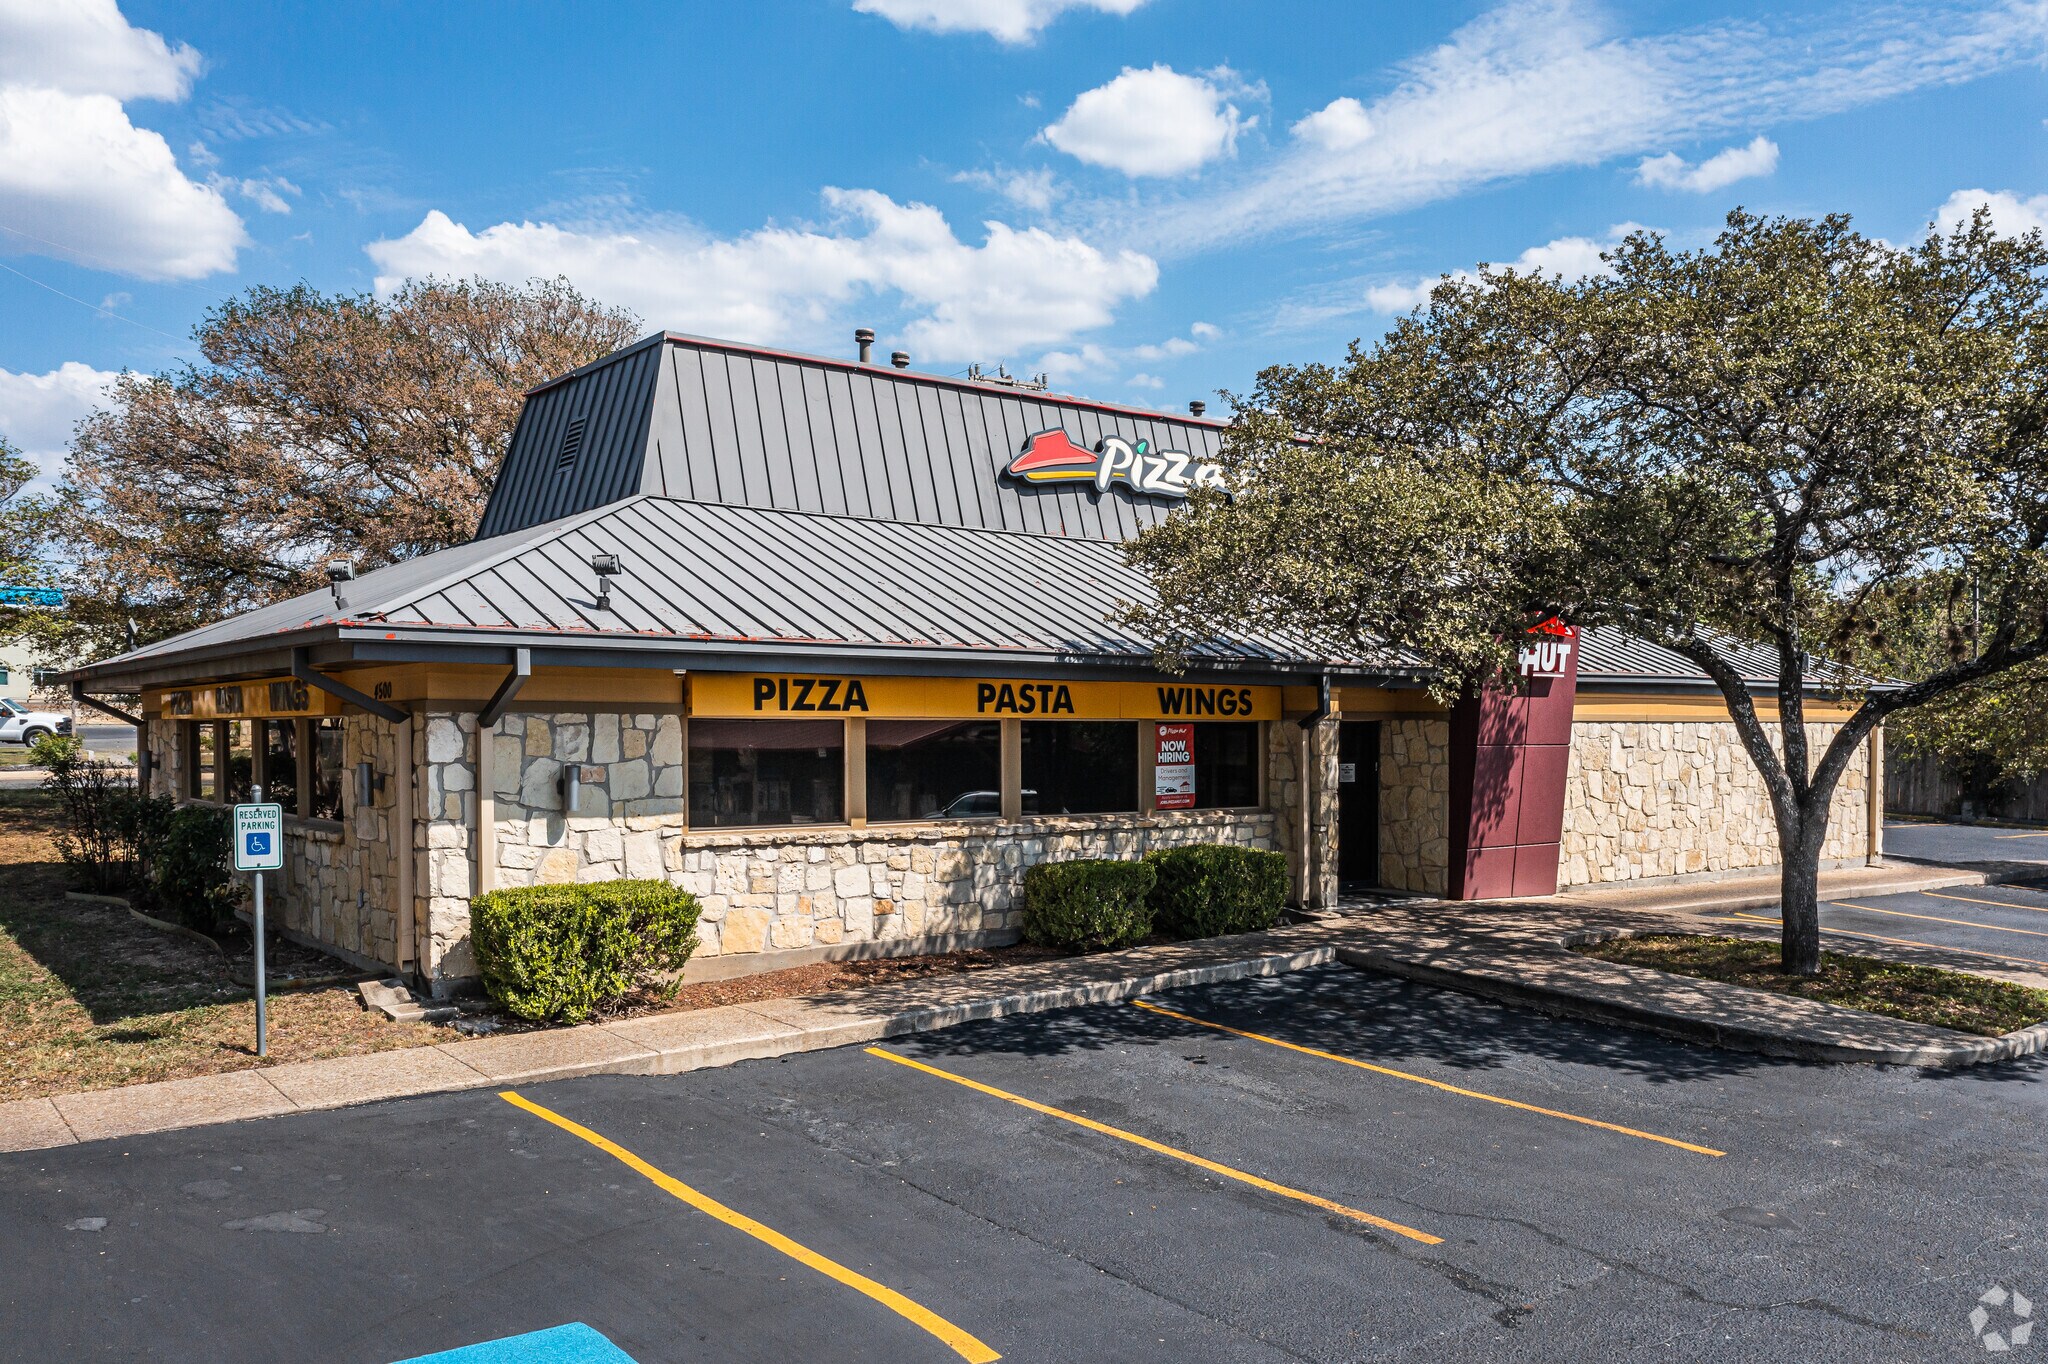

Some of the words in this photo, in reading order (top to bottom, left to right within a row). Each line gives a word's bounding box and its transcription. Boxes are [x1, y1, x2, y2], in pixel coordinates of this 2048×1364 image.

[1100, 438, 1227, 492] Pizza
[1518, 642, 1571, 676] HUT
[374, 681, 392, 700] 4500
[754, 678, 869, 711] PIZZA
[978, 683, 1074, 714] PASTA
[1157, 687, 1253, 716] WINGS
[1161, 740, 1186, 751] NOW
[1158, 751, 1190, 763] HIRING
[239, 810, 277, 820] RESERVED
[241, 821, 275, 830] PARKING
